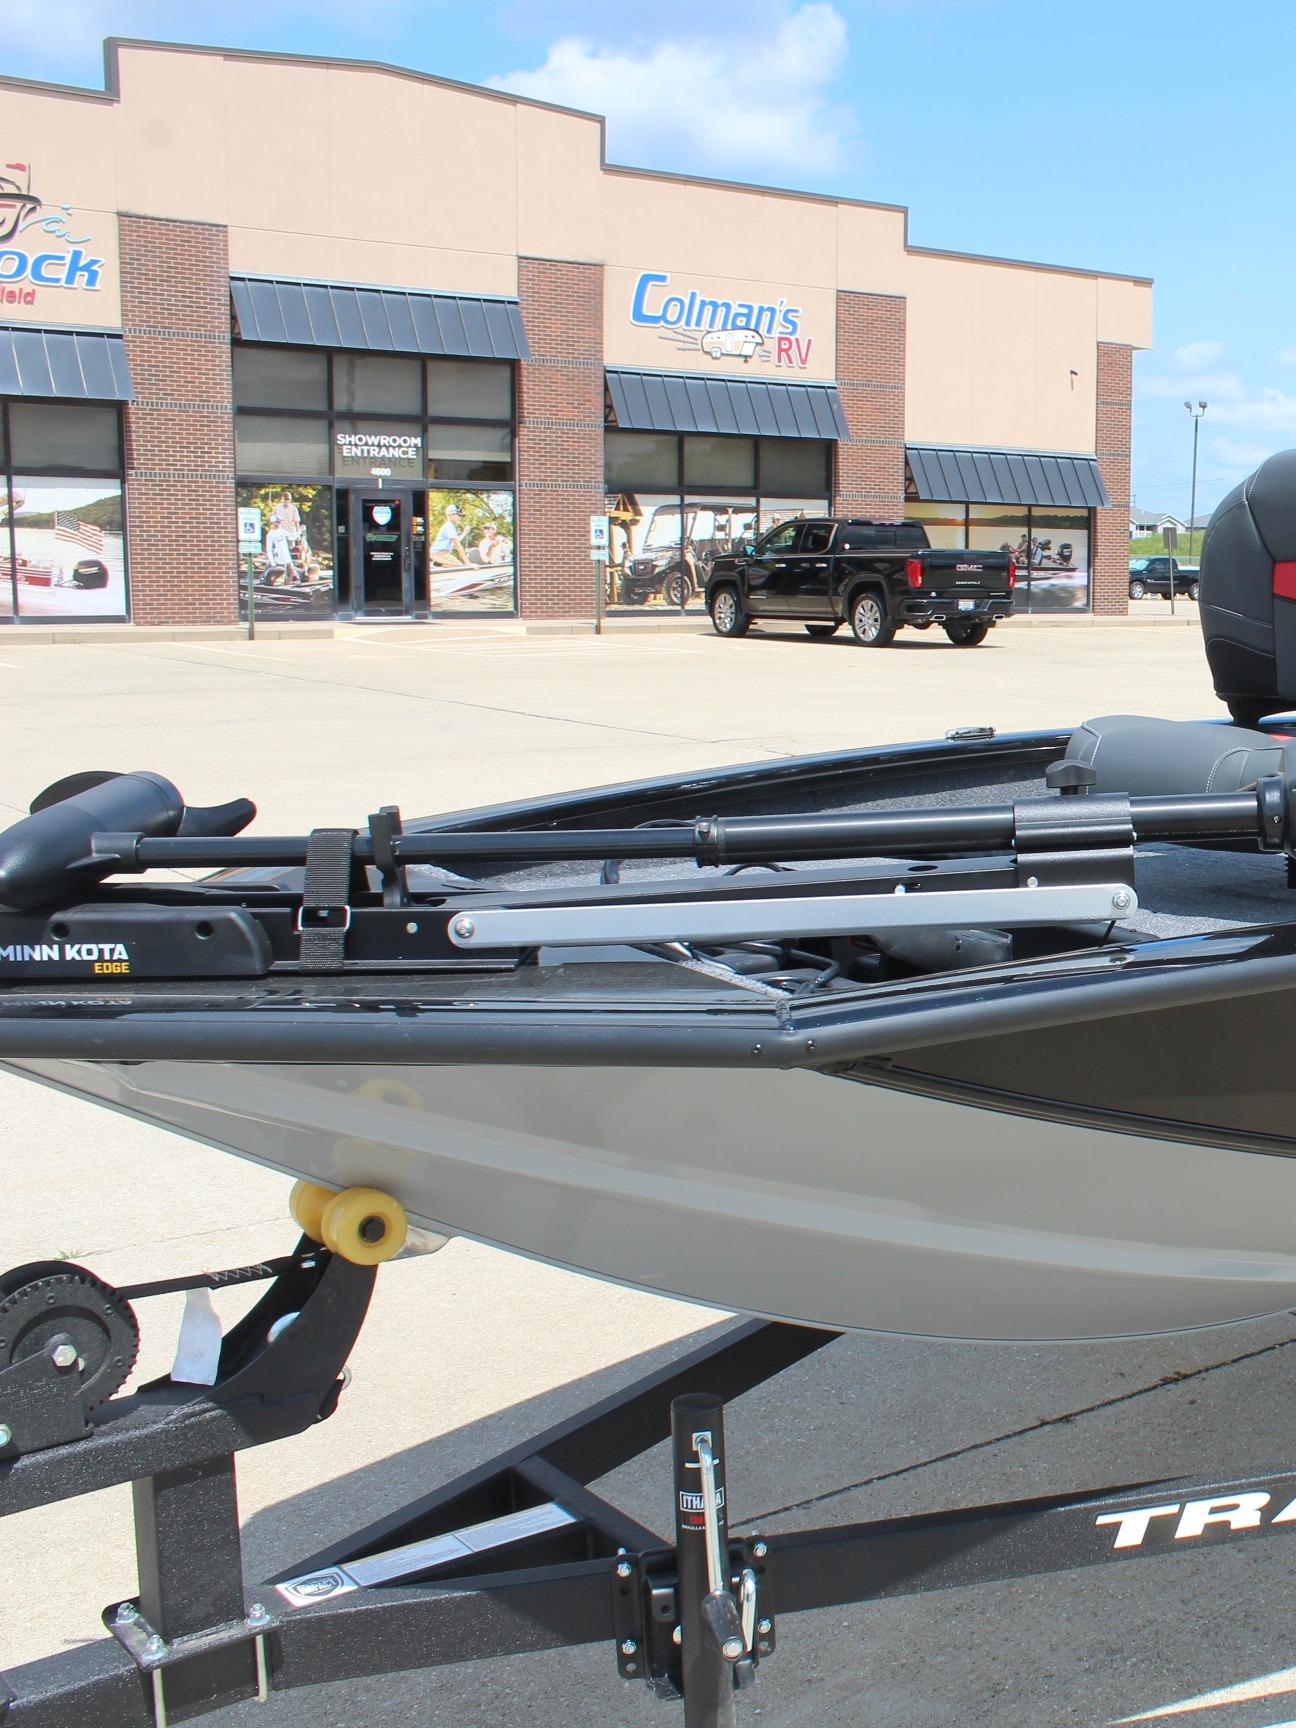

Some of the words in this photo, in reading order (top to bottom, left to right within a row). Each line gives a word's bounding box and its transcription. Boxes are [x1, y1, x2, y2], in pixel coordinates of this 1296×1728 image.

[630, 273, 801, 337] Colman's
[776, 336, 812, 366] RV
[337, 433, 422, 447] SHOWROOM
[342, 446, 417, 458] ENTRANCE
[370, 467, 391, 476] 4600
[0, 944, 60, 961] MINN
[65, 943, 129, 961] KOTA
[94, 962, 130, 974] EDGE
